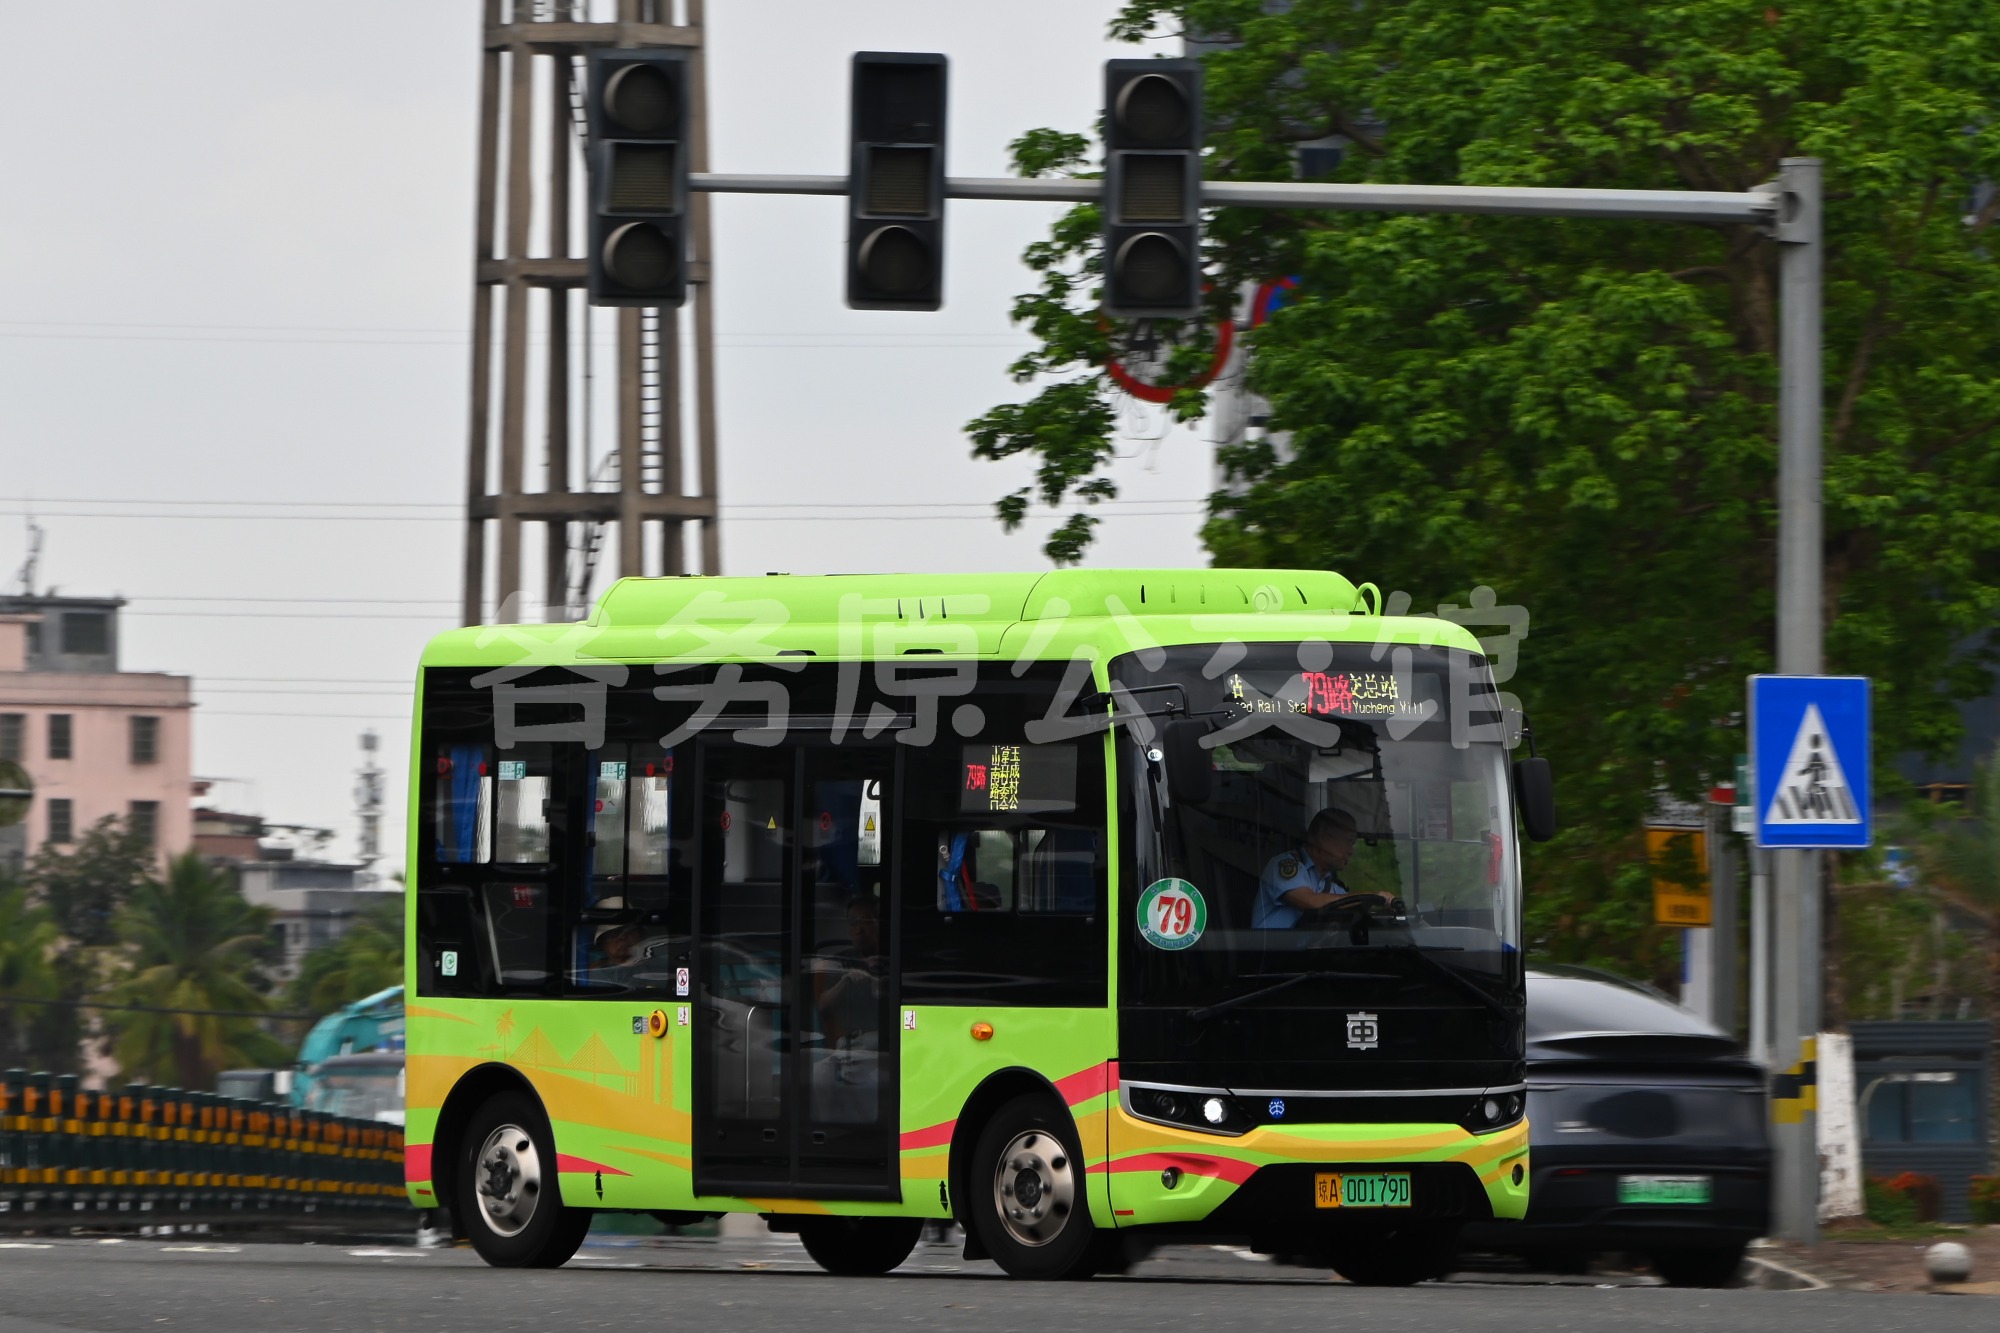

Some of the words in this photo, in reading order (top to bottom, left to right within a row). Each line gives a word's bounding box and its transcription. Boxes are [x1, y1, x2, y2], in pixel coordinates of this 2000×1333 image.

[1302, 672, 1352, 714] 79路
[1258, 700, 1281, 713] Rail
[1352, 702, 1396, 715] Yucheng
[1401, 702, 1424, 714] Vill
[1158, 896, 1192, 935] 79
